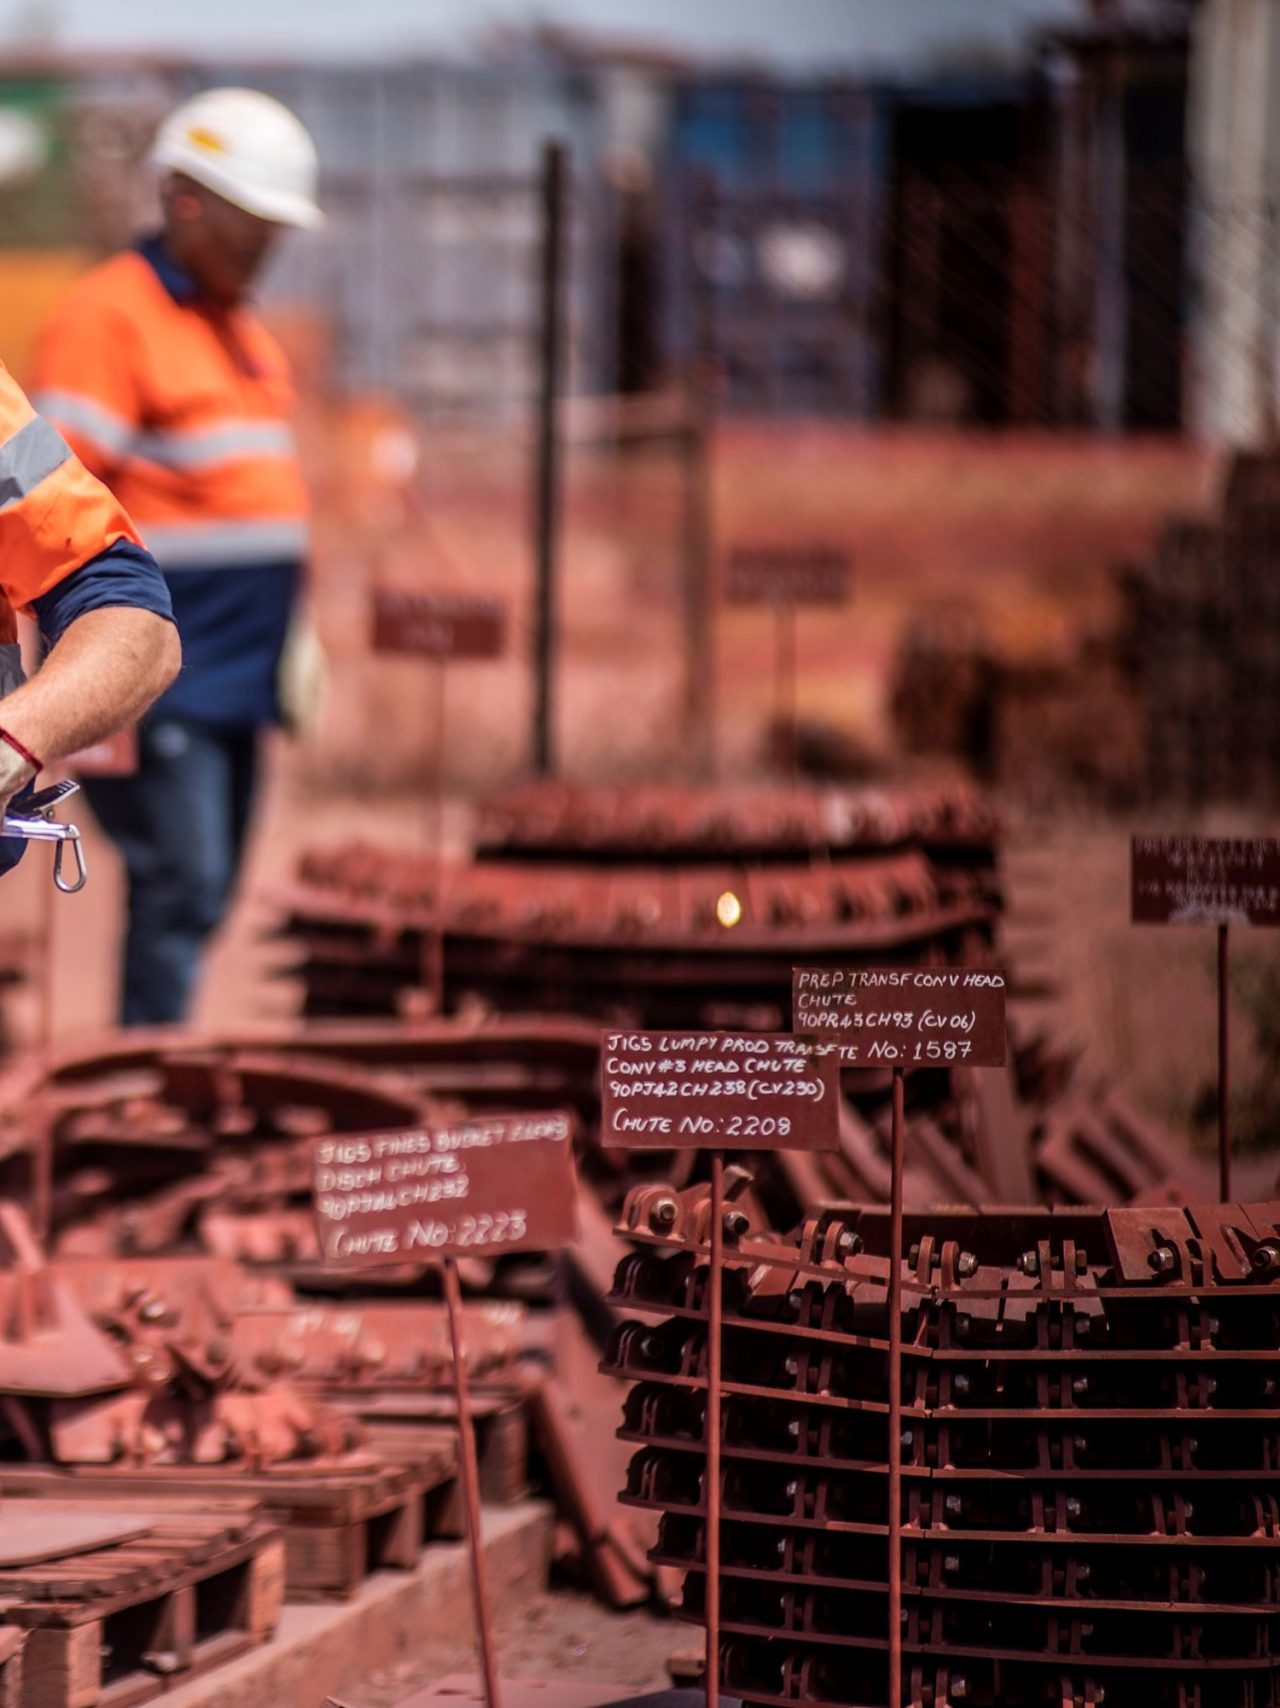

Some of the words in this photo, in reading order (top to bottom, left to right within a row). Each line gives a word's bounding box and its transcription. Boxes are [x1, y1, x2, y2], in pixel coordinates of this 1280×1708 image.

[798, 972, 843, 989] PREP
[848, 972, 913, 987] TRANSF
[913, 973, 958, 987] CONV
[963, 974, 1005, 988] HEAD
[798, 993, 857, 1009] CHUTE
[607, 1035, 652, 1052] JIGS
[659, 1037, 718, 1052] LUMPY
[721, 1037, 770, 1054] PROD
[691, 1059, 740, 1074] HEAD
[744, 1058, 807, 1074] CHUTE
[613, 1108, 672, 1133] CHUTE
